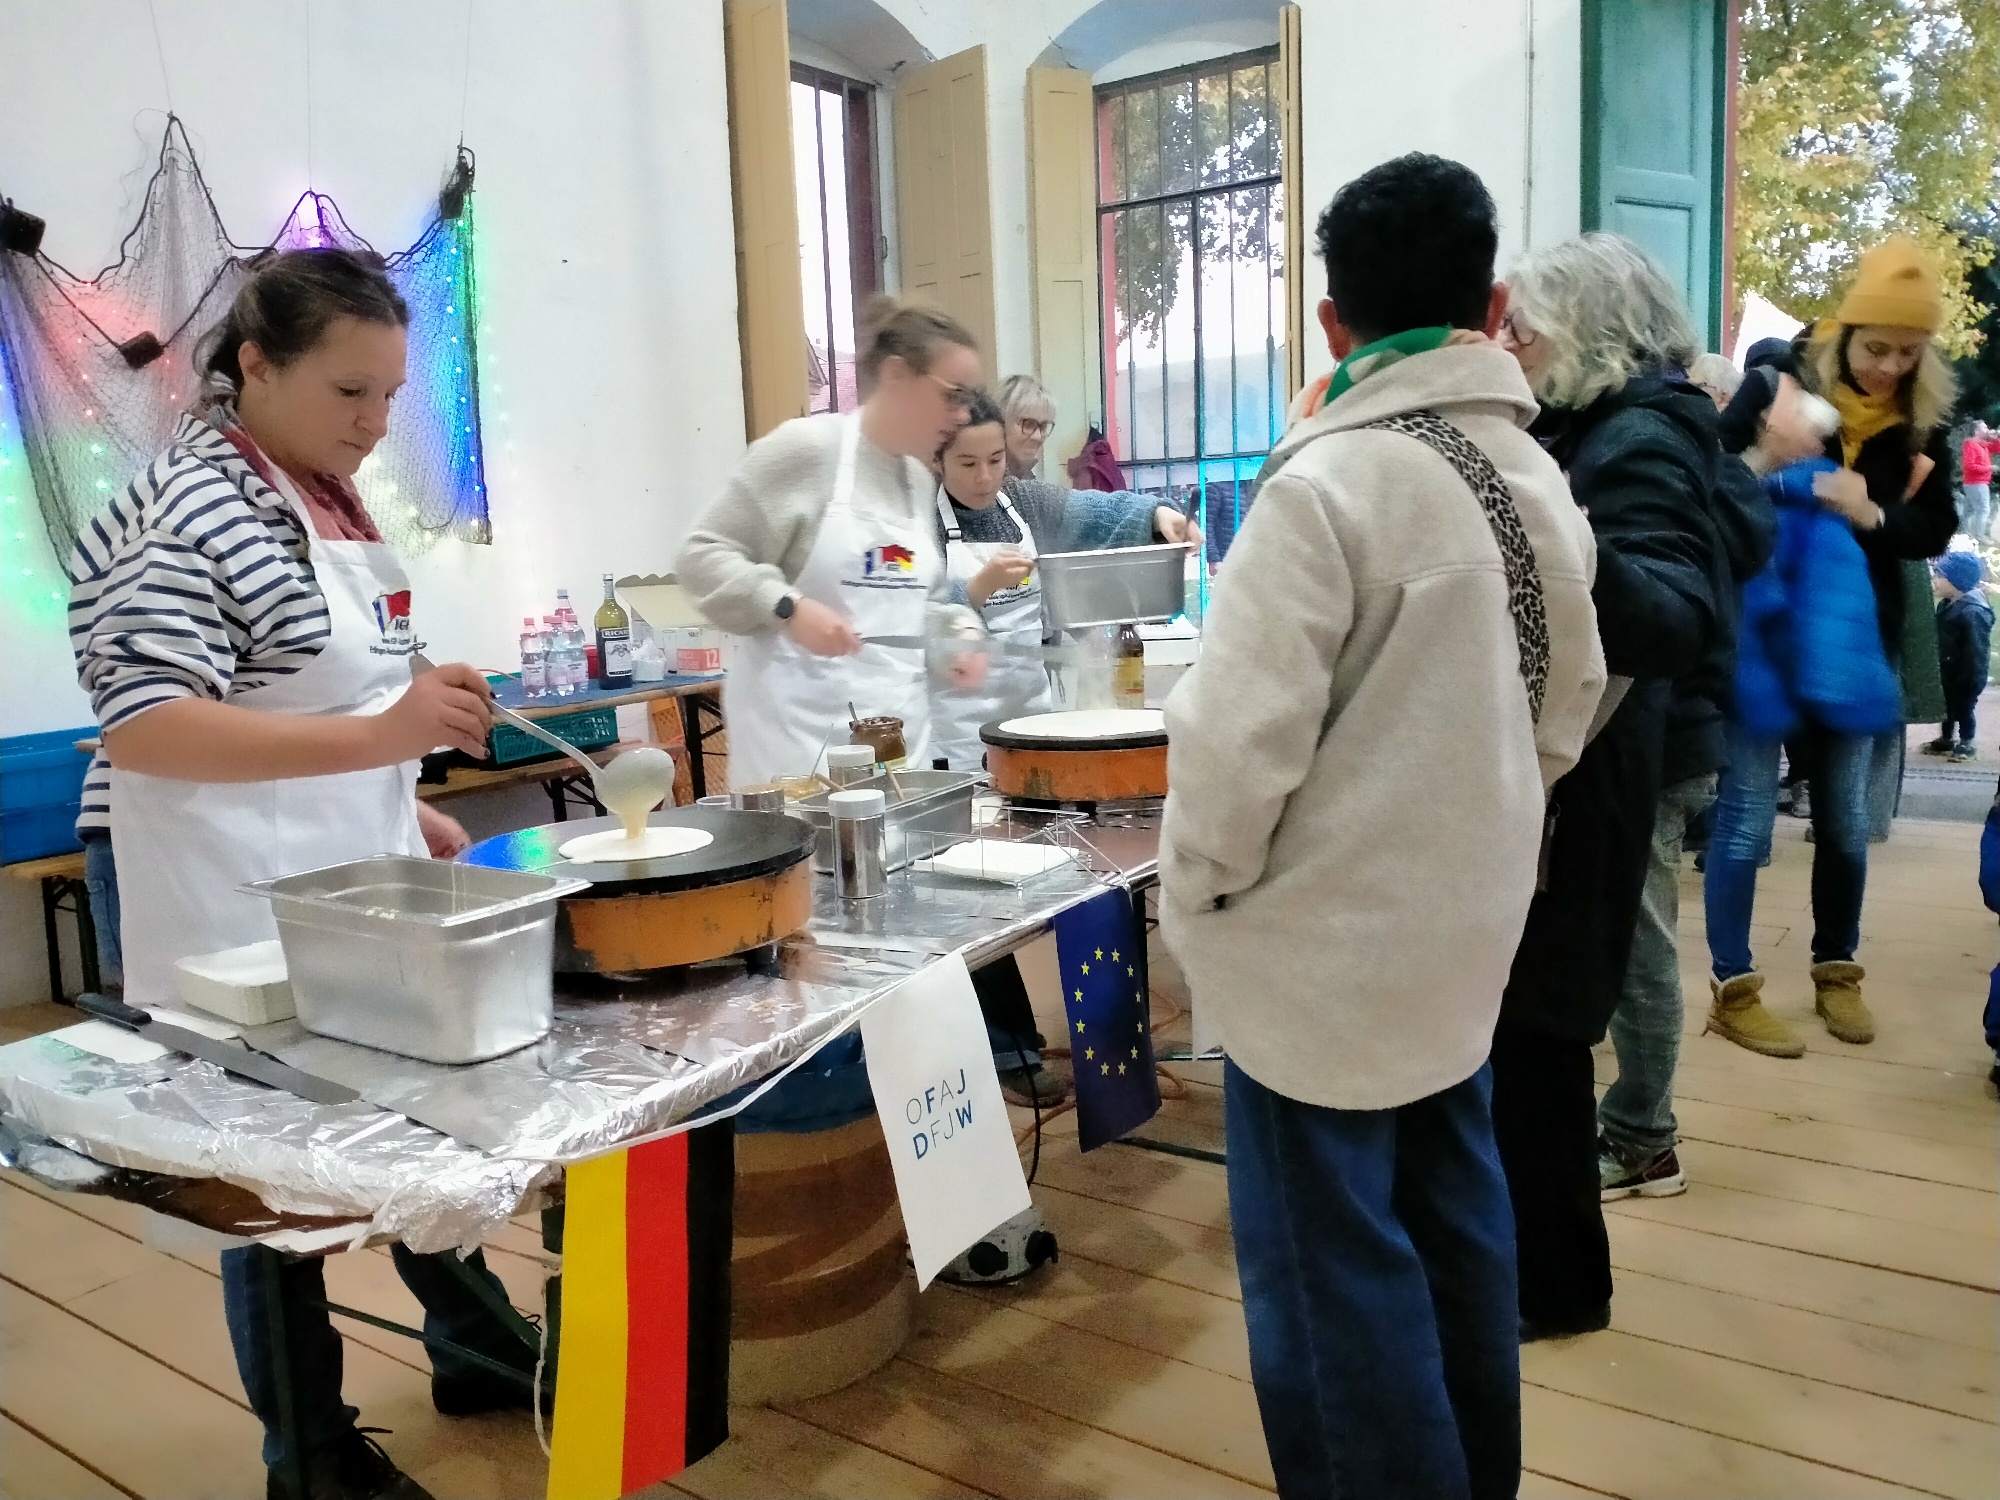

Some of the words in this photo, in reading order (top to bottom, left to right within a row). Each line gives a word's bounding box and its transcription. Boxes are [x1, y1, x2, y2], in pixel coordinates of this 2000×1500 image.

[706, 648, 719, 668] 12
[906, 1068, 966, 1125] OFAJ
[912, 1099, 973, 1160] DFJW
